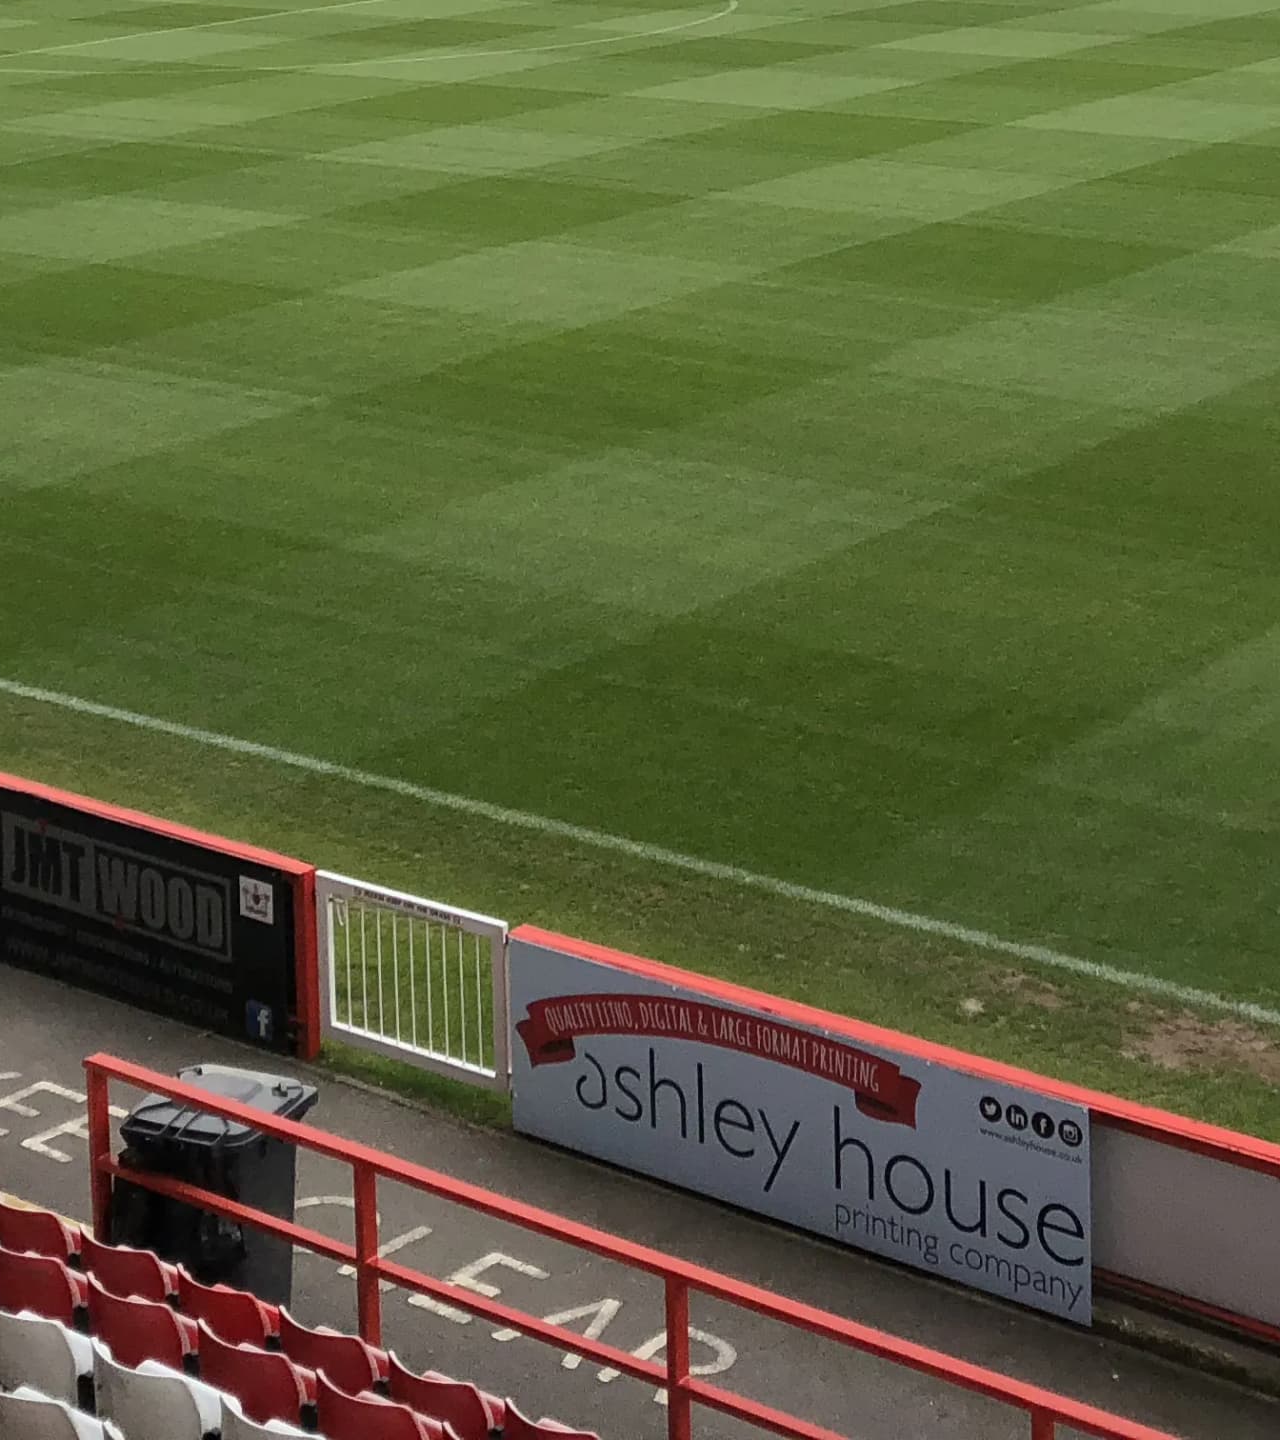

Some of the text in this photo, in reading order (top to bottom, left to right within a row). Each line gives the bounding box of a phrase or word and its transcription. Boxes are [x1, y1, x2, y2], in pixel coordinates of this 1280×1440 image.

[11, 825, 223, 947] JMT WOOD
[544, 1001, 880, 1093] QUALITY LITHO, DIGITAL & LARGE FORMAT PRINTING
[576, 1047, 1085, 1267] ashley house
[835, 1202, 1084, 1314] printing company
